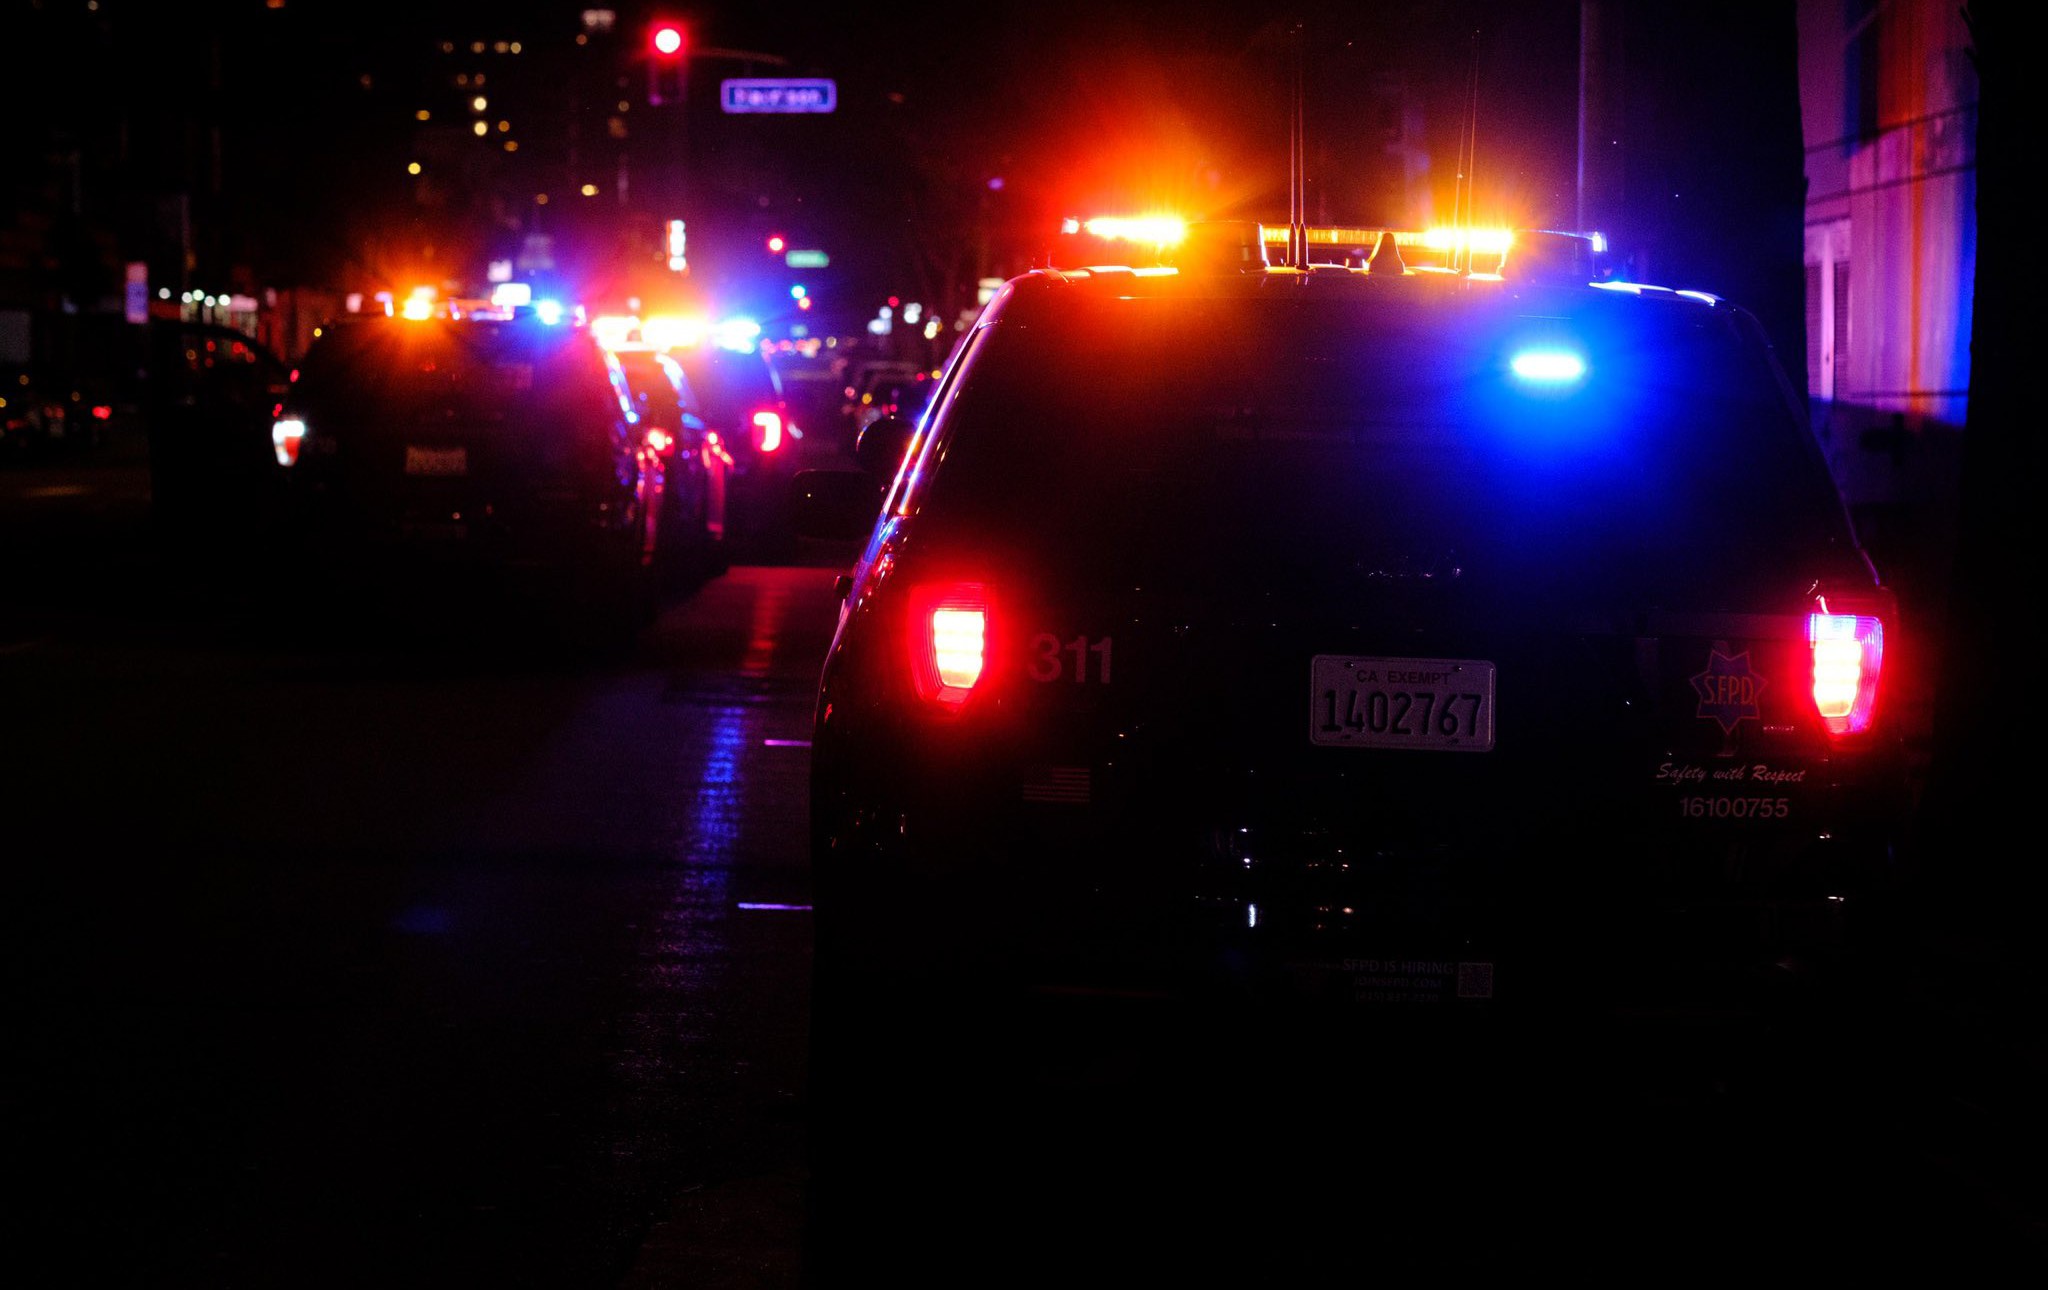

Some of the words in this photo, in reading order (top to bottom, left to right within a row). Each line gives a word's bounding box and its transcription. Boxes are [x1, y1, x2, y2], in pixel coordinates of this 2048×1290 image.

[1028, 632, 1113, 684] 311
[1356, 669, 1378, 683] CA
[1388, 670, 1451, 685] EXEMPT
[1321, 689, 1482, 737] 1402767
[1656, 763, 1707, 785] Safety
[1713, 765, 1746, 781] with
[1752, 765, 1807, 784] Respect
[1679, 797, 1789, 818] 16100755
[1343, 958, 1380, 972] SFPD
[1384, 960, 1397, 973] IS
[1401, 960, 1454, 975] HIRING
